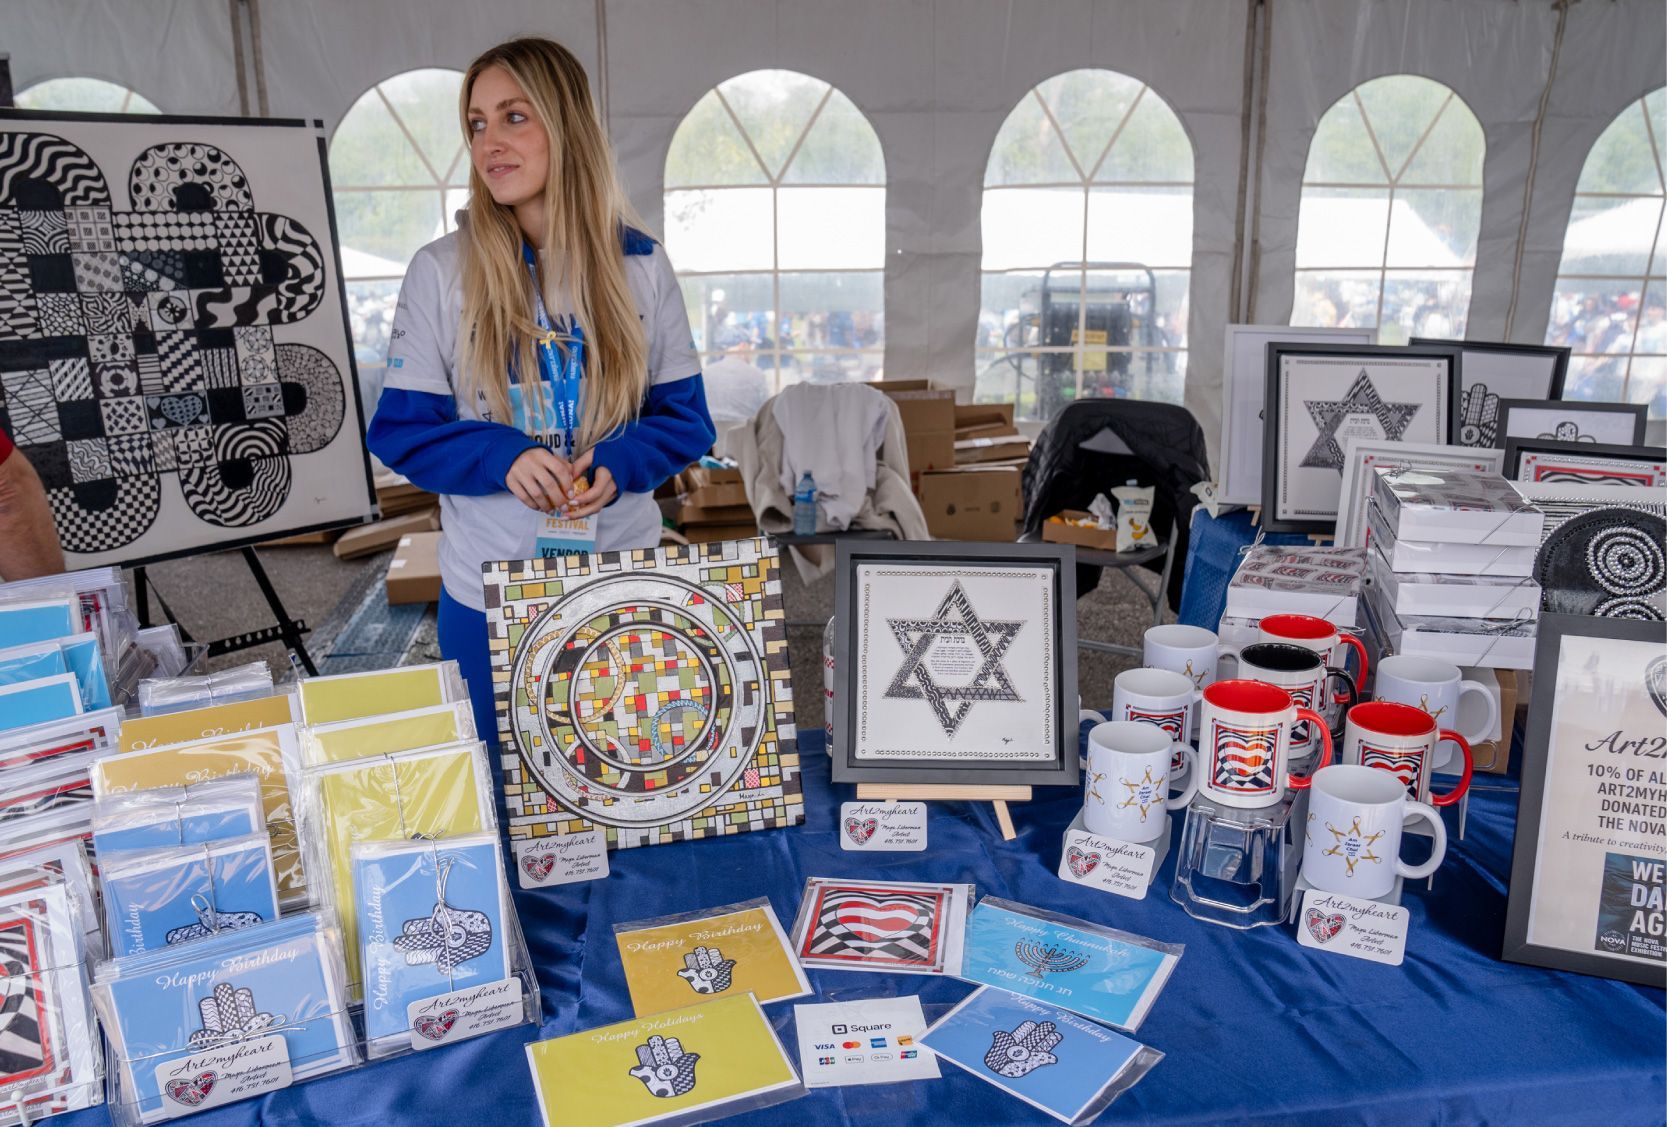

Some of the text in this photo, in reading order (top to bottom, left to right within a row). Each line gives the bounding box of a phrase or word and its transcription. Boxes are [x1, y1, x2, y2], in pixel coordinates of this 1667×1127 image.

[545, 517, 590, 530] FESTIVAL
[1587, 763, 1621, 780] 10%
[1626, 767, 1645, 782] OF
[852, 805, 918, 820] Art2myheart
[1601, 798, 1667, 819] DONATED
[1598, 815, 1667, 837] THE NOVA
[525, 836, 596, 853] Art2myheart
[1074, 836, 1146, 859] Art2myheart
[1572, 833, 1605, 844] tribute
[1607, 838, 1617, 846] to
[1632, 860, 1665, 884] WE
[1313, 896, 1400, 920] Art2myheart
[1630, 883, 1667, 912] DA
[124, 902, 146, 954] Birthday
[367, 884, 387, 954] Birthday
[1004, 916, 1049, 937] Happy
[1629, 910, 1667, 937] AG
[626, 922, 764, 953] Happy Birthday
[1600, 936, 1626, 946] NOVA
[155, 948, 298, 991] Happy Birthday
[987, 966, 1073, 997] חג חנוכה שמח
[419, 984, 510, 1013] Art2myheart
[591, 1012, 705, 1044] Happy Holidays
[850, 1023, 892, 1033] Square
[1010, 991, 1114, 1043] Happy Birthday
[170, 1041, 273, 1077] Art2myheart
